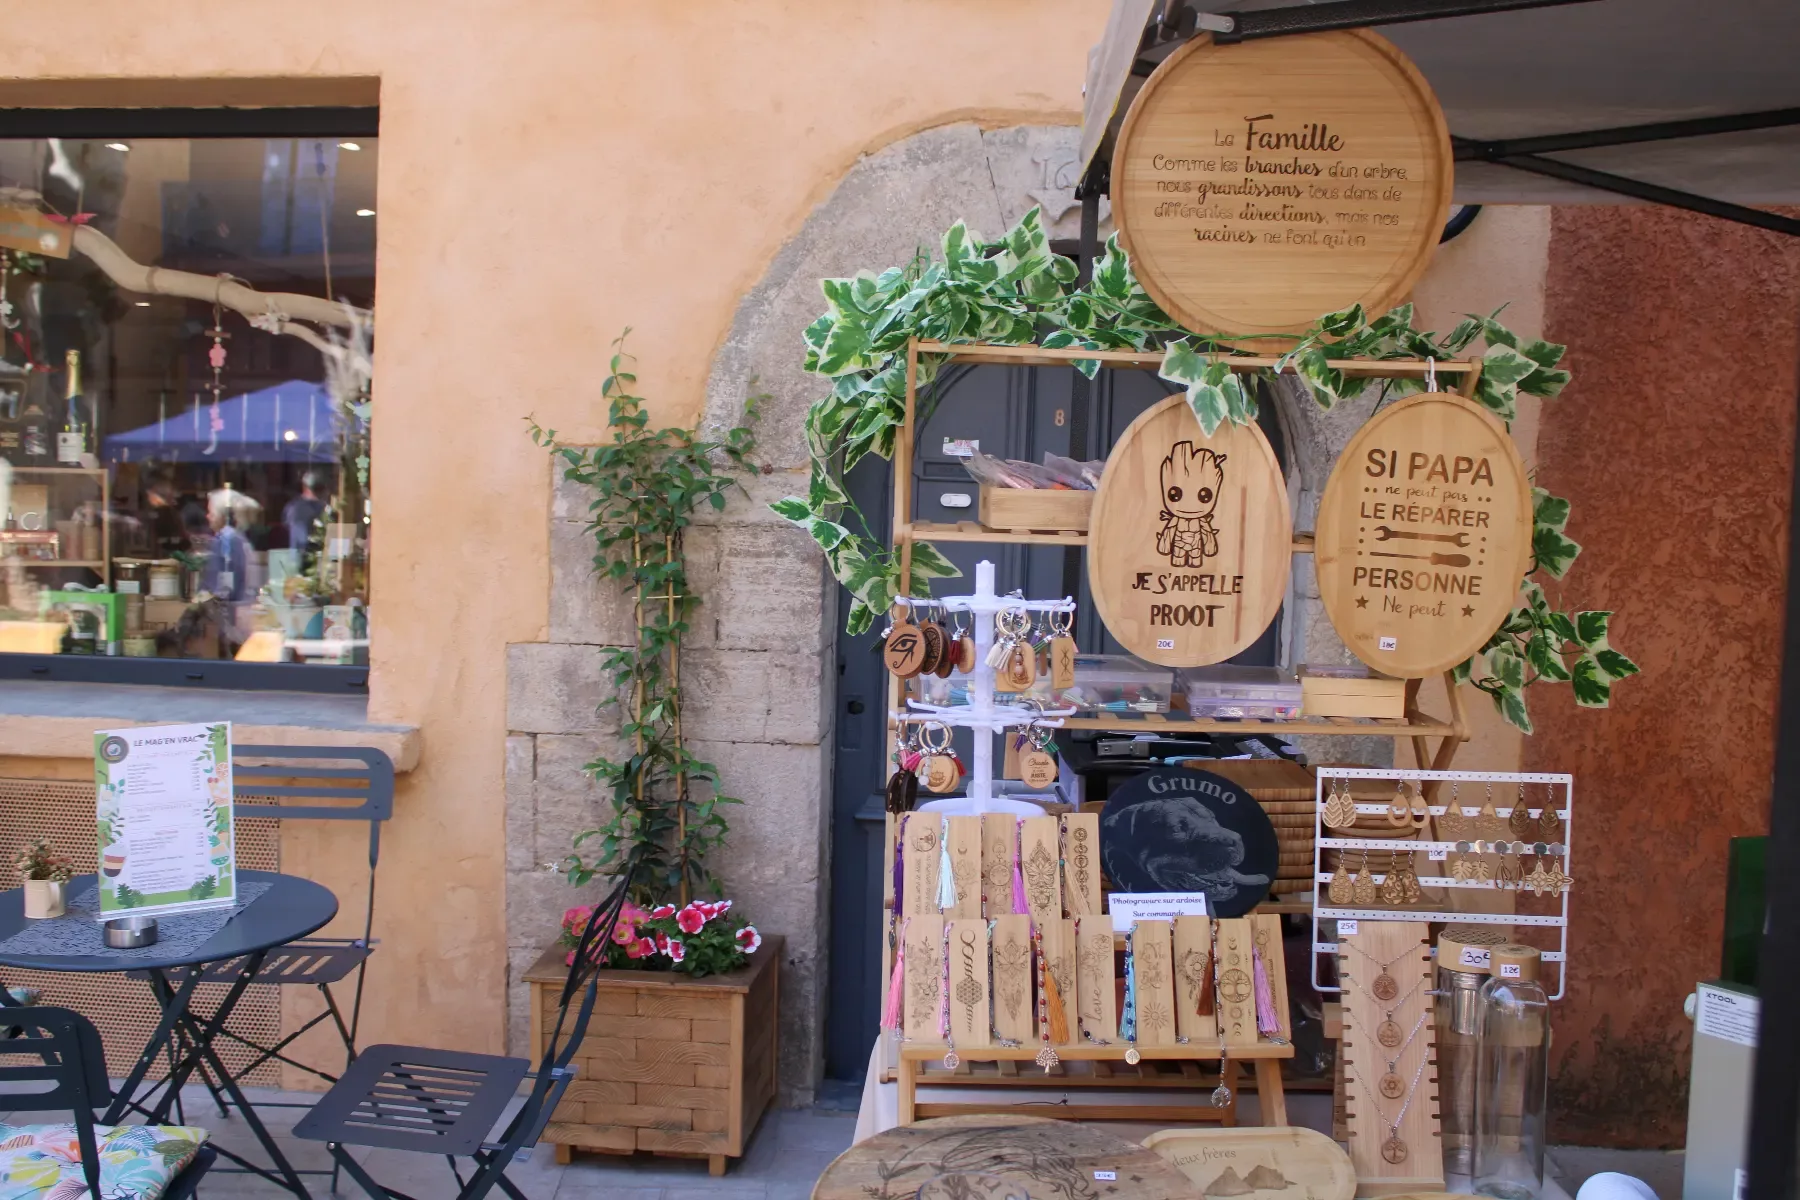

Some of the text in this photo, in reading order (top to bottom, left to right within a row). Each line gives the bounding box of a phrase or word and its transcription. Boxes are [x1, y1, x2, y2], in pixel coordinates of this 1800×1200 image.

[1215, 114, 1345, 151] La Famille
[1153, 154, 1216, 172] Comme
[1220, 156, 1238, 173] les
[1245, 156, 1323, 176] branches
[1156, 177, 1402, 205] nous grandissons tous dans de
[1153, 202, 1234, 219] différentes
[1334, 209, 1369, 225] mais
[1373, 211, 1401, 226] nos
[1193, 224, 1258, 243] racines
[1263, 231, 1282, 243] ne
[1285, 229, 1318, 245] font
[1055, 409, 1065, 426] 8
[1365, 448, 1494, 487] SI PAPA
[1385, 486, 1468, 503] ne peut pas
[1360, 501, 1490, 529] LE RÉPARER
[1132, 572, 1244, 595] JE S'APPELLE
[1353, 566, 1483, 596] PERSONNE
[1150, 604, 1225, 627] PROOT
[1384, 595, 1446, 618] Ne peut
[1157, 640, 1172, 648] 20€
[133, 739, 143, 747] LE
[1147, 774, 1237, 805] Grumo
[1111, 897, 1162, 906] Photogravure
[1176, 896, 1203, 904] ardoise
[1132, 909, 1185, 918] Sur commande
[1340, 922, 1357, 931] 25€
[1463, 951, 1490, 964] 30€
[1503, 966, 1519, 974] 12€
[1706, 992, 1737, 1004] XTOOL
[1171, 1146, 1237, 1169] deux frères
